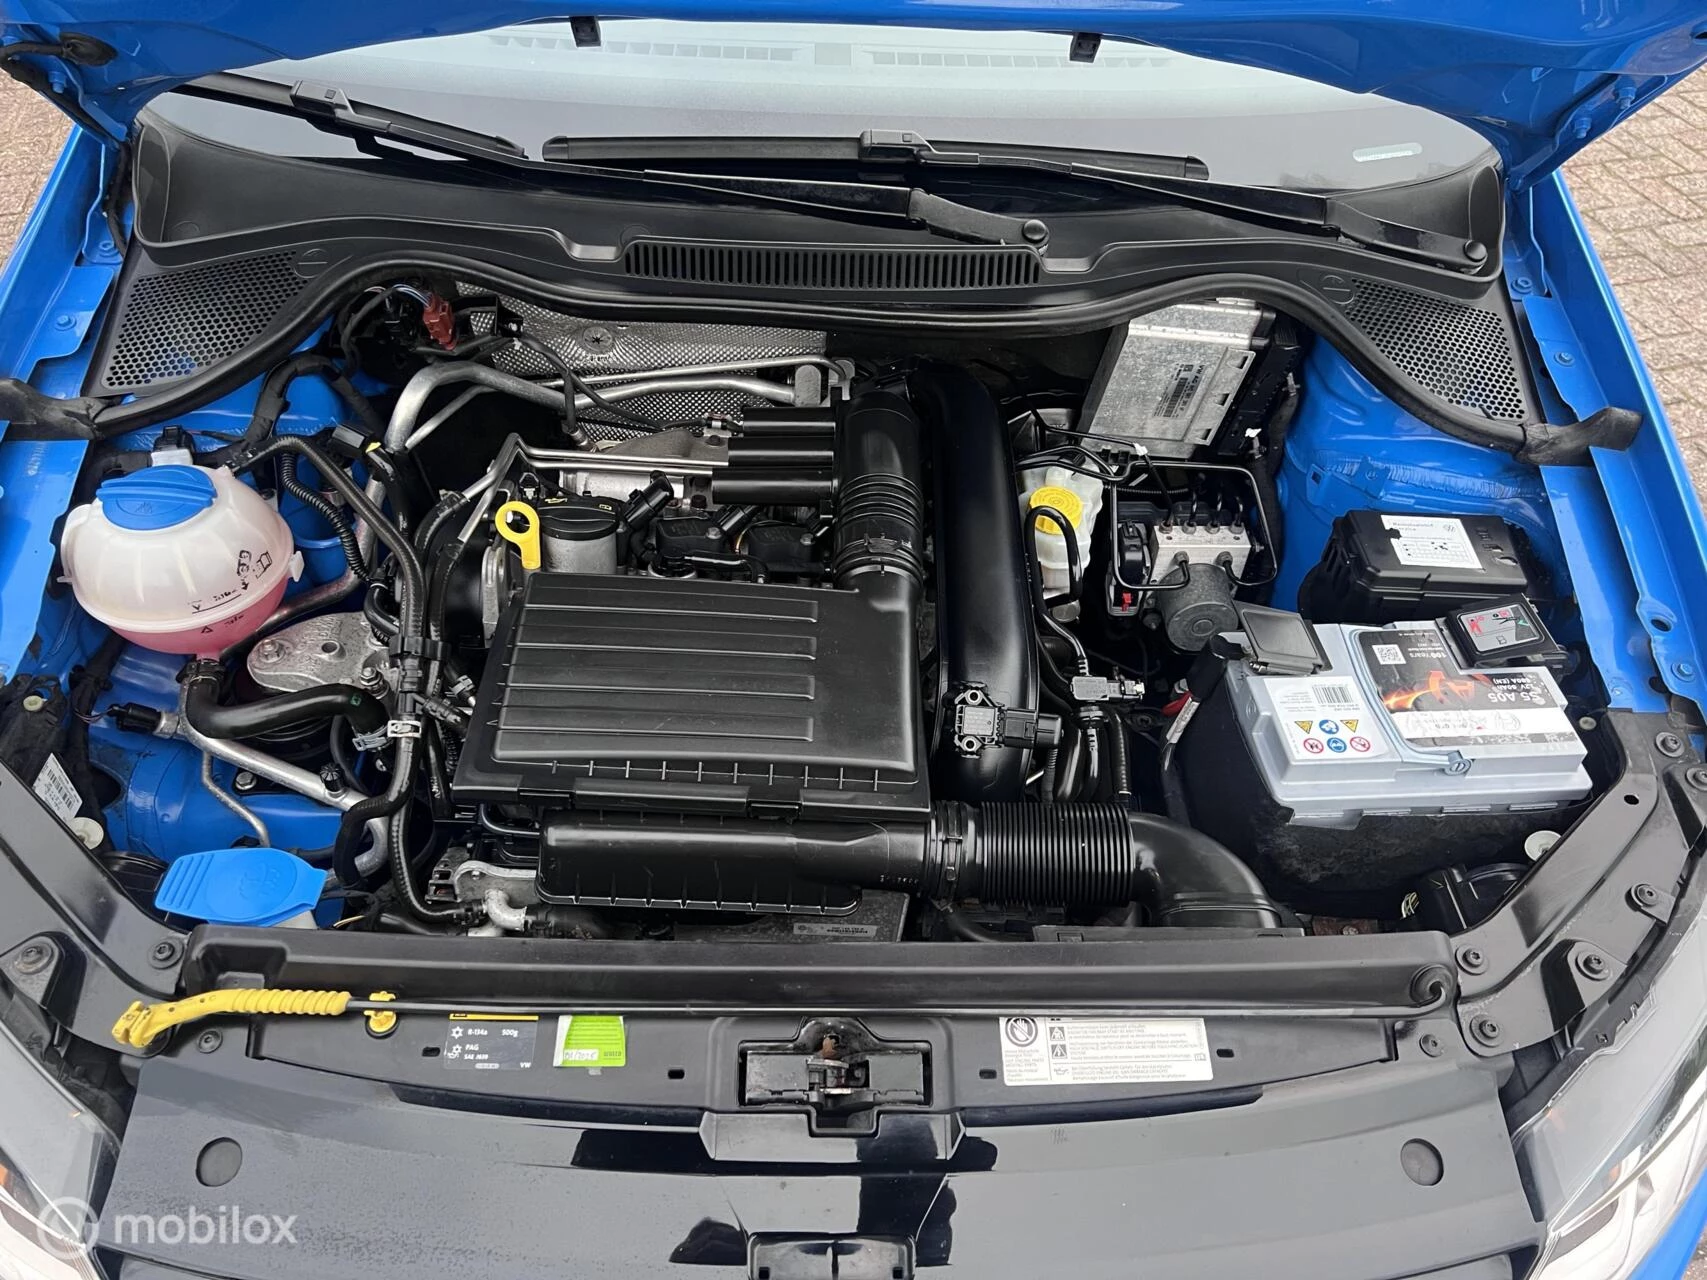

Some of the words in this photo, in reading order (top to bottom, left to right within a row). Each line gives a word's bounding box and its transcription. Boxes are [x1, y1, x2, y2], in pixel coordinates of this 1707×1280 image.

[1487, 692, 1516, 702] A05
[467, 1028, 488, 1036] R-134a
[501, 1029, 519, 1038] 500g
[519, 1061, 532, 1069] VW
